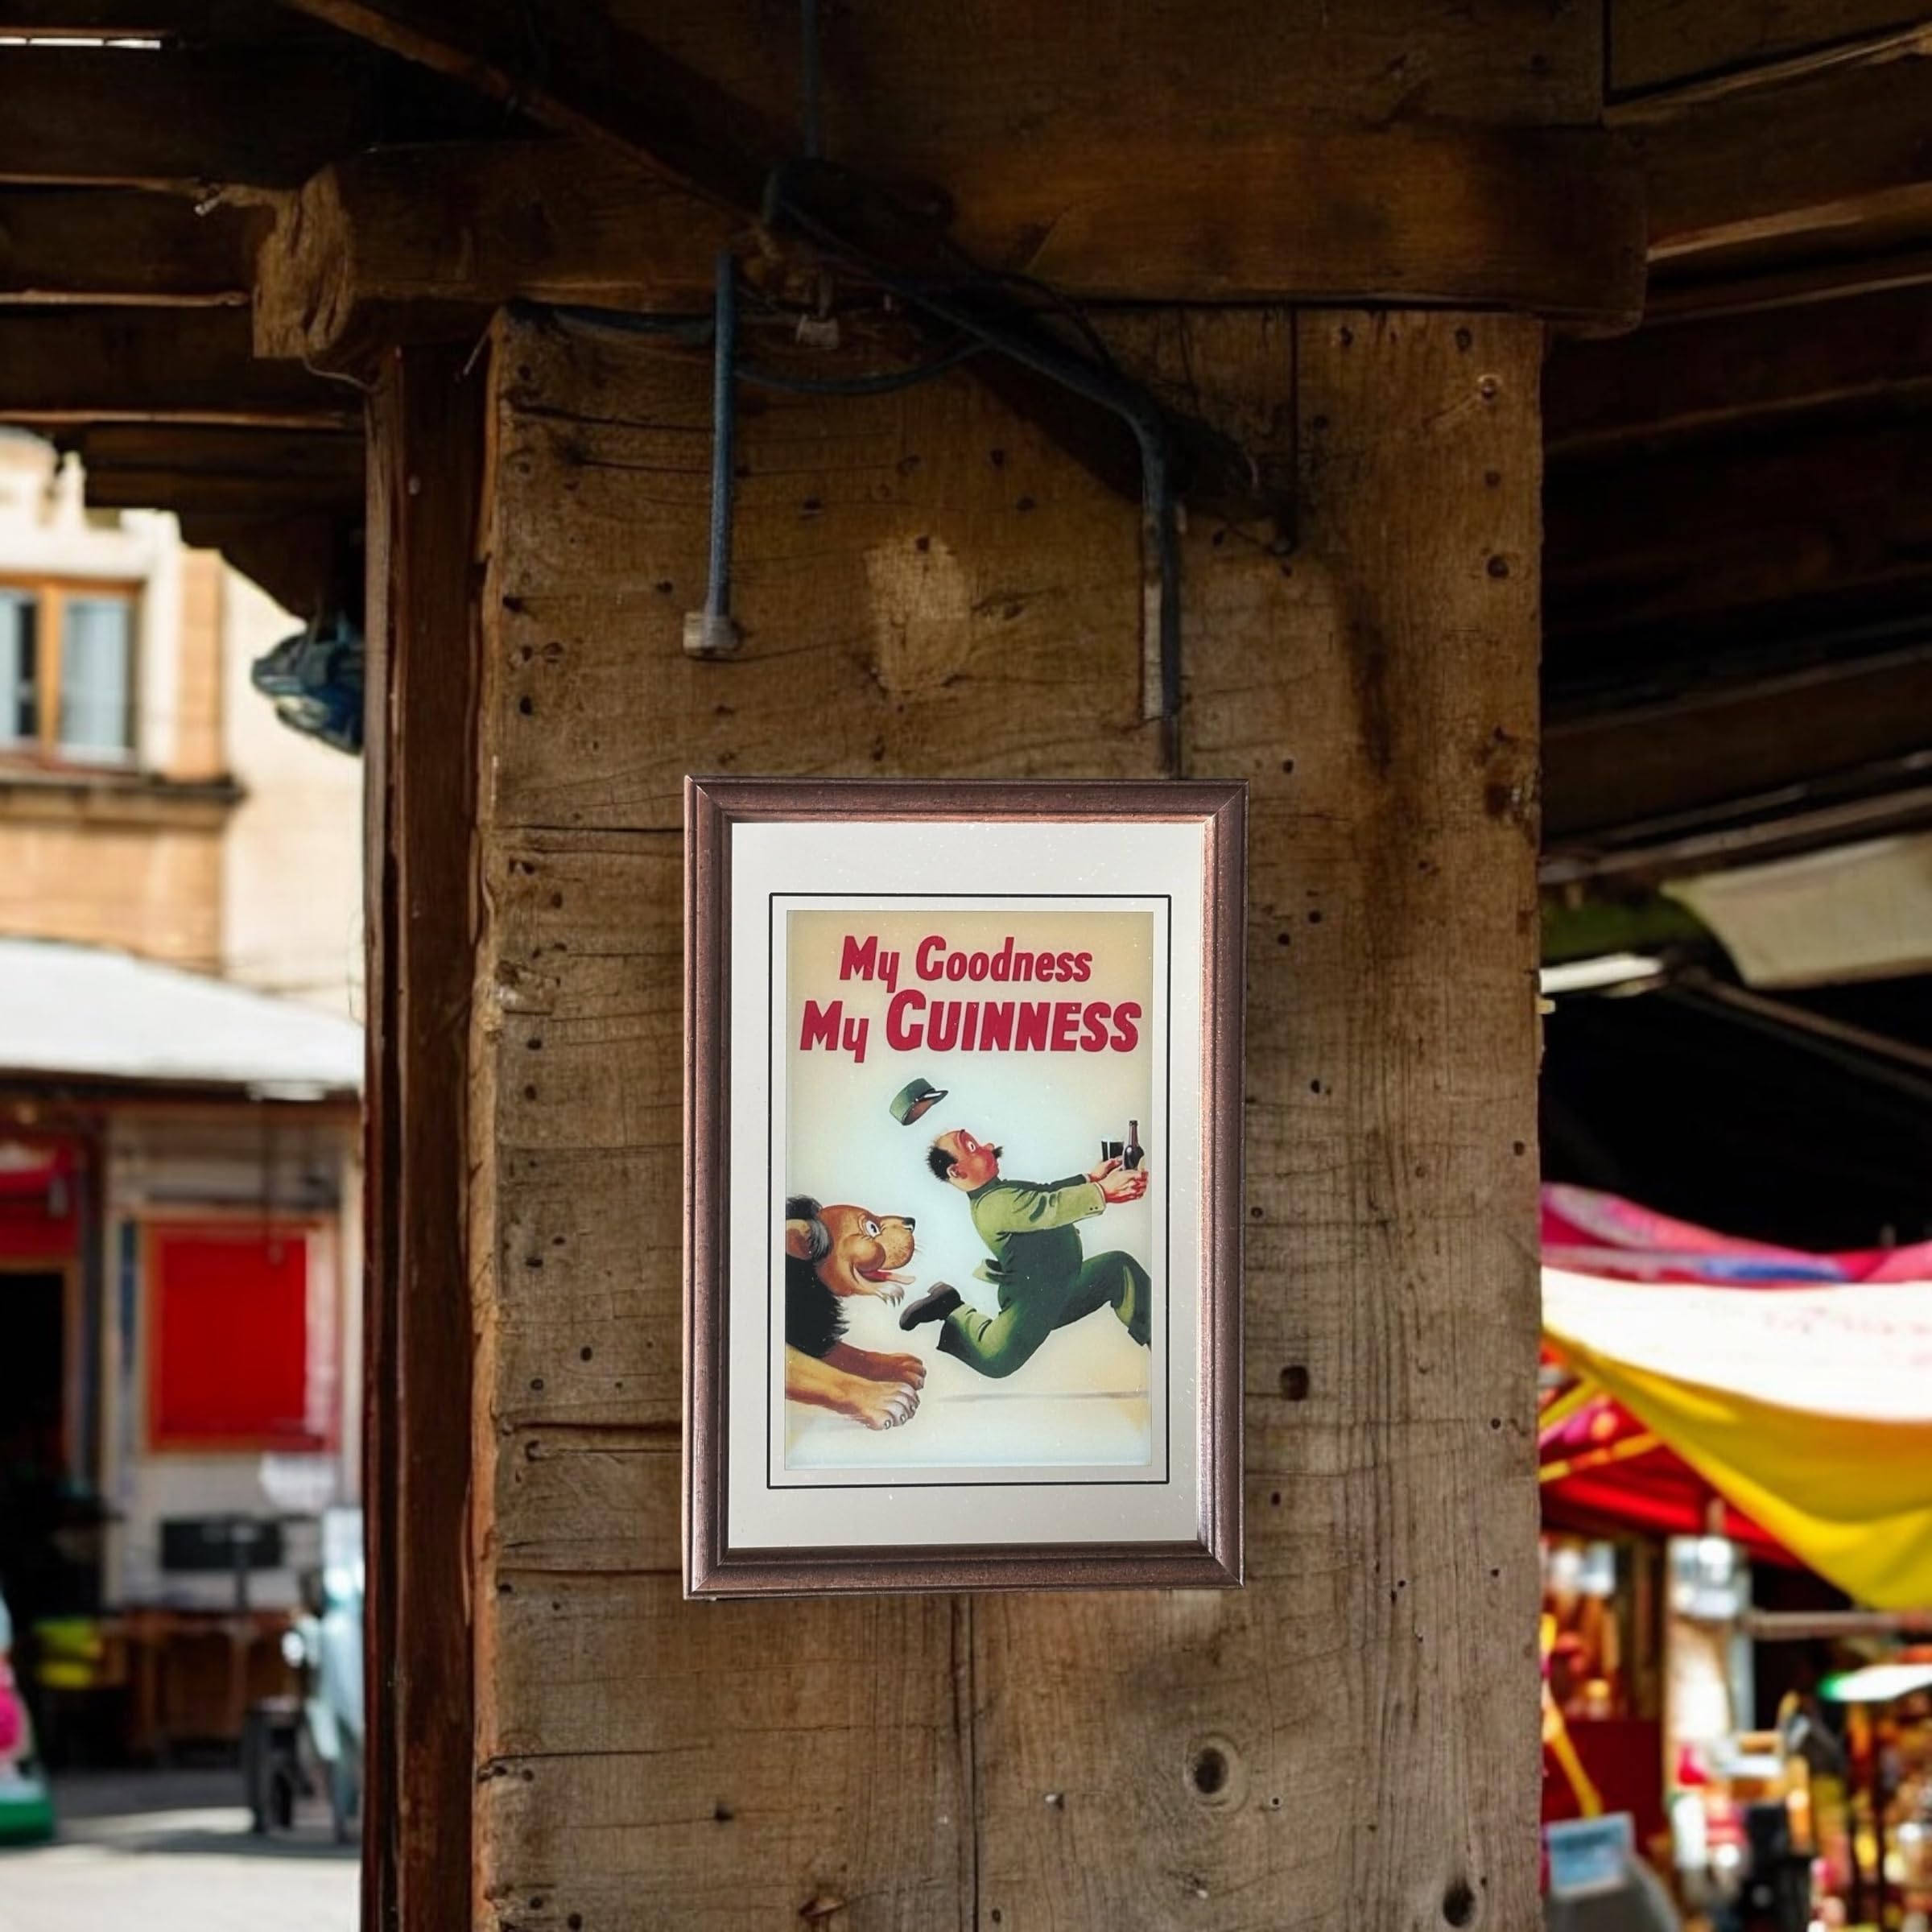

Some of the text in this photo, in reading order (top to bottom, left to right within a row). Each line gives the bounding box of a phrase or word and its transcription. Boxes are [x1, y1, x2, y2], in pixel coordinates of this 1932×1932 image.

[840, 935, 1092, 992] My Goodness
[800, 989, 1141, 1063] My GUINNESS
